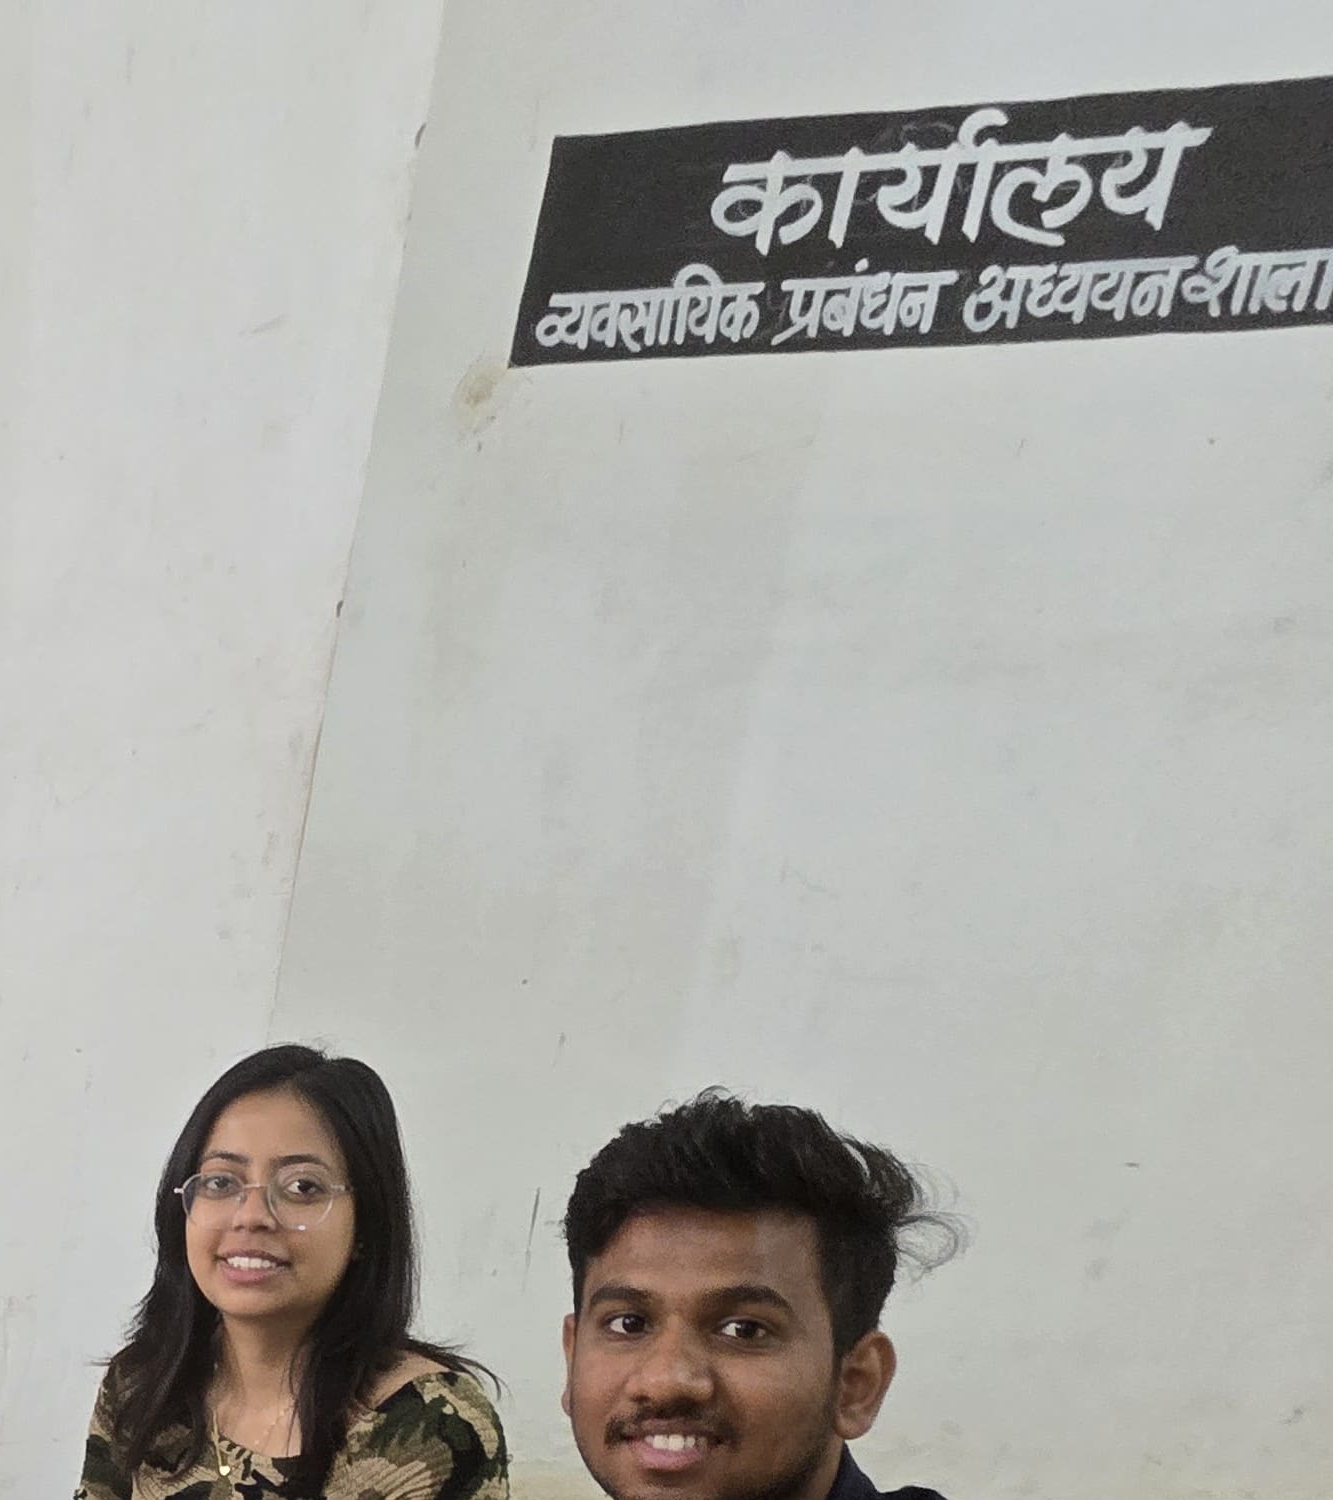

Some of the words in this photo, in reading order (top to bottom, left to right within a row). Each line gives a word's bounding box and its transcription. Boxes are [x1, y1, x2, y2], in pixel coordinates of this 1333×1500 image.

[711, 107, 1213, 256] कार्यालय
[535, 263, 765, 351] व्यवसायिक
[771, 258, 959, 346] प्रबंधन
